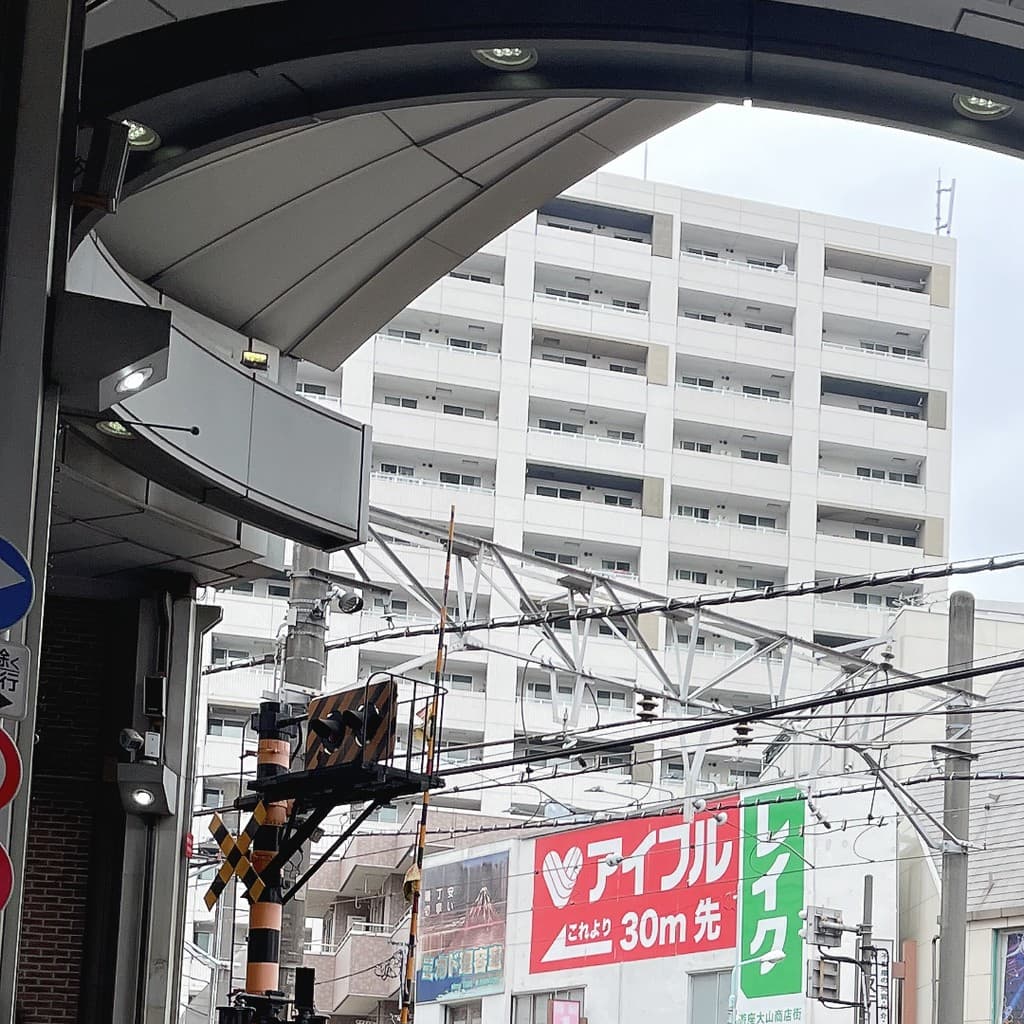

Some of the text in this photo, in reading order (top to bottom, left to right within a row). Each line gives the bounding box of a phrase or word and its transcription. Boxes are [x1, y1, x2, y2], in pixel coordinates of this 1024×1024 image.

[587, 820, 732, 903] アイフル
[750, 803, 790, 975] レイク
[567, 897, 721, 951] これより 30m 先
